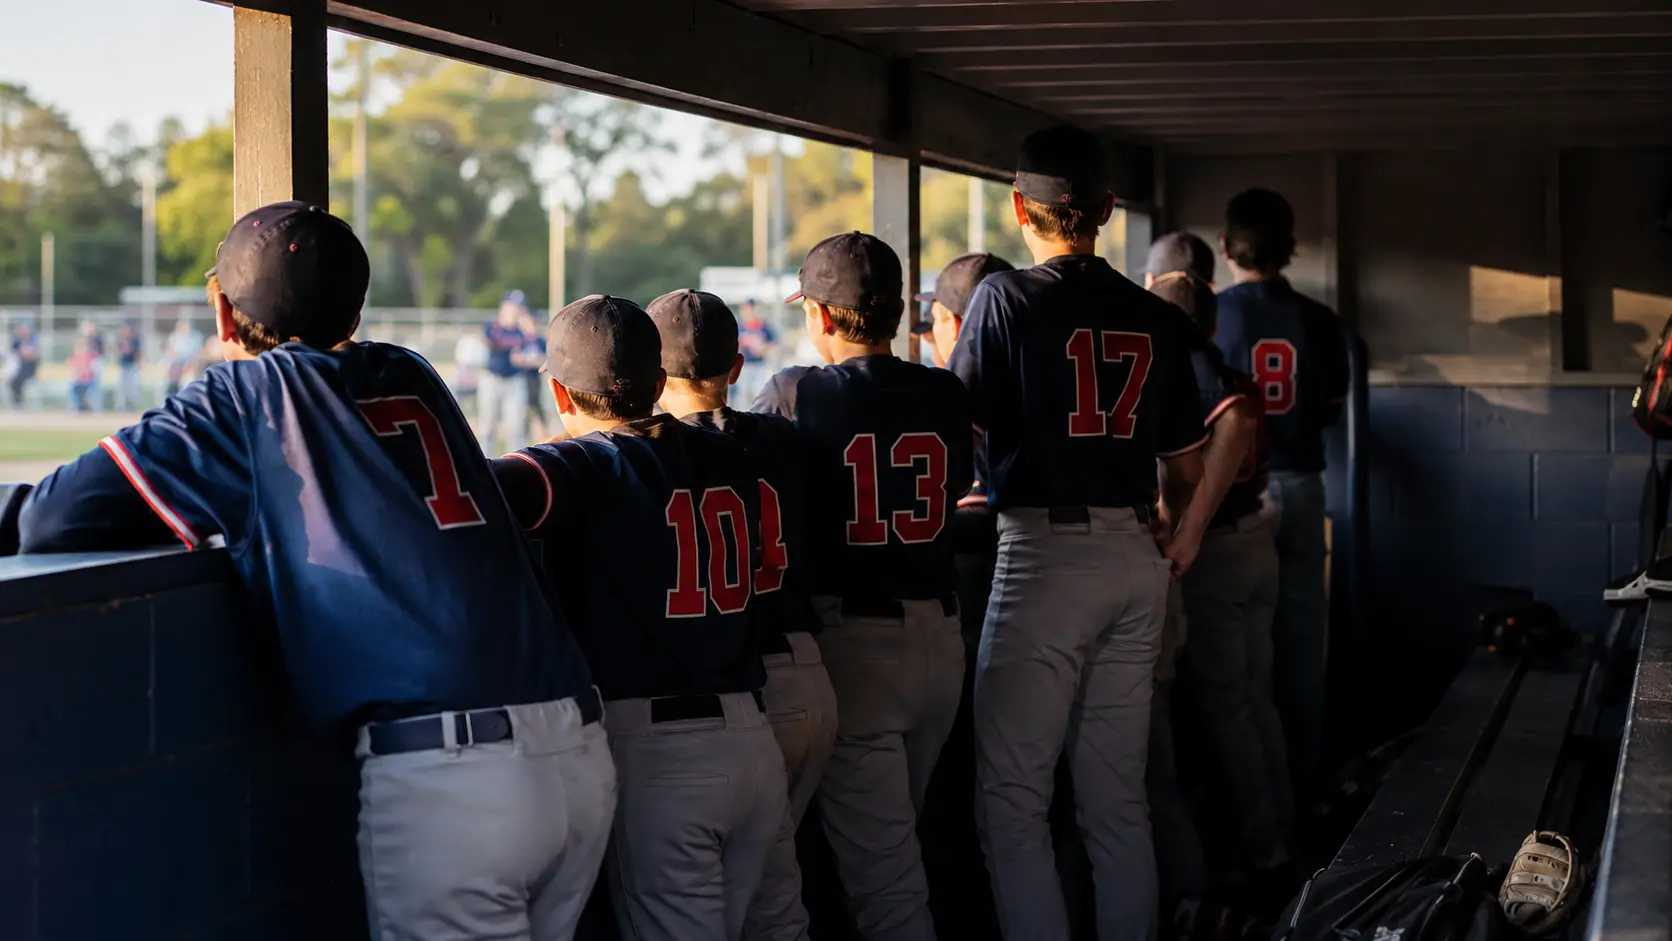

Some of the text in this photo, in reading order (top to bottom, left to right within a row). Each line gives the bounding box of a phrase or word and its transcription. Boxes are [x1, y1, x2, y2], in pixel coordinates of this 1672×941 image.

[1066, 328, 1153, 439] 17
[1251, 338, 1297, 416] 8
[355, 395, 487, 530] 7
[843, 432, 948, 546] 13
